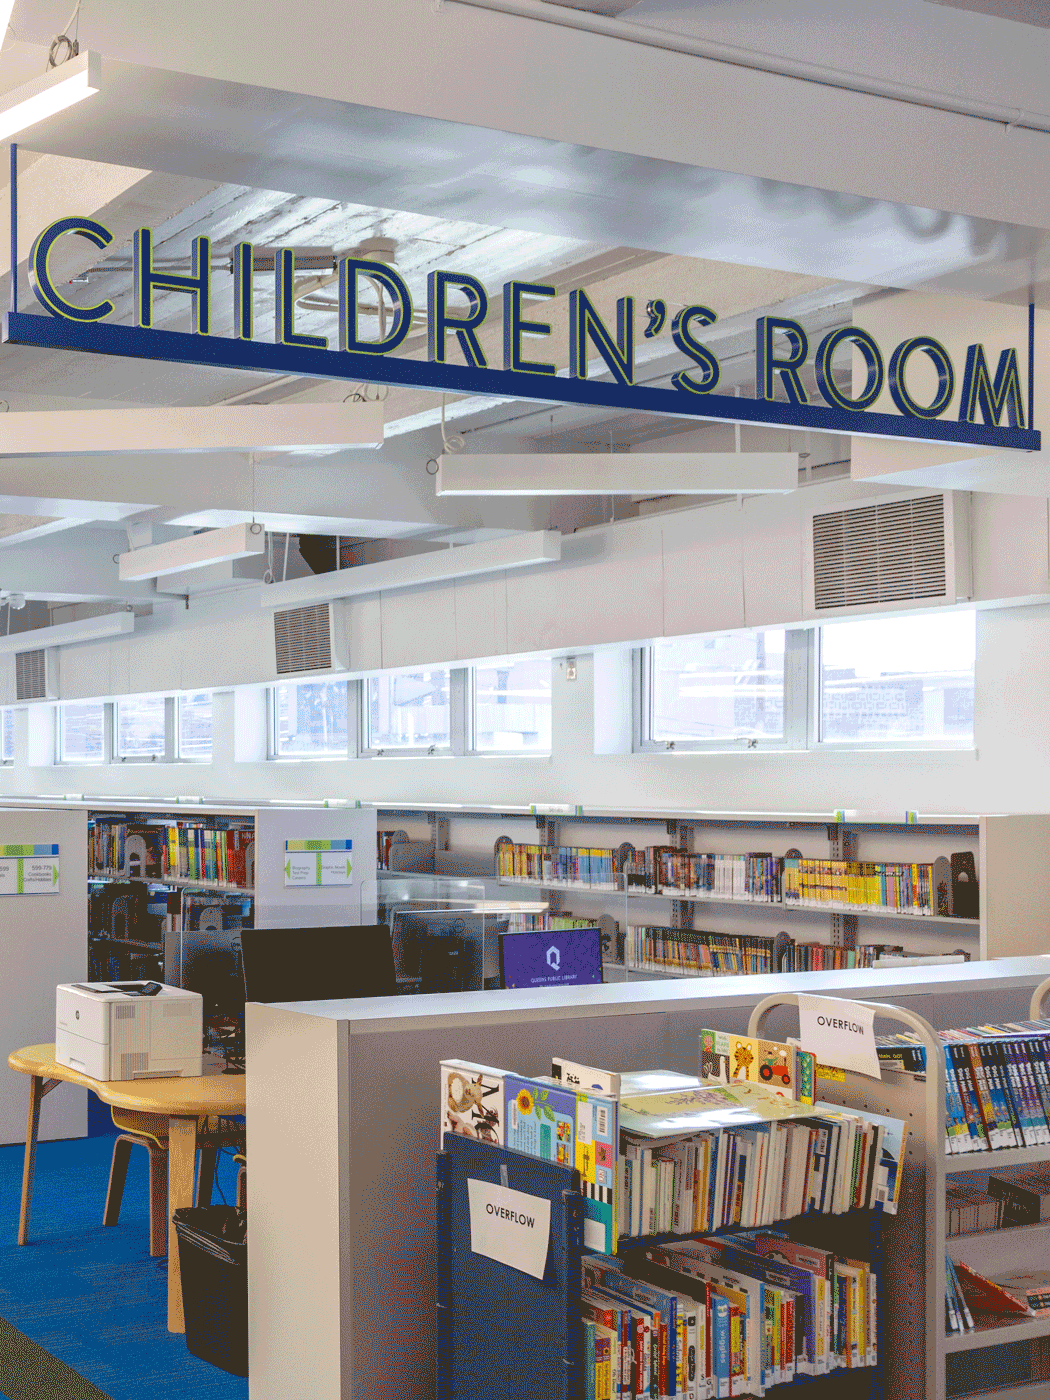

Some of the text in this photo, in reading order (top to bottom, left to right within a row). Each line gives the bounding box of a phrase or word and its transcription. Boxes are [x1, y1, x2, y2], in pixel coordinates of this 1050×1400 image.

[29, 216, 1027, 430] CHILDREN'S ROOM
[817, 1016, 864, 1035] OVERFLOW
[486, 1203, 535, 1228] OVERFLOW
[718, 1330, 727, 1364] wiggles
